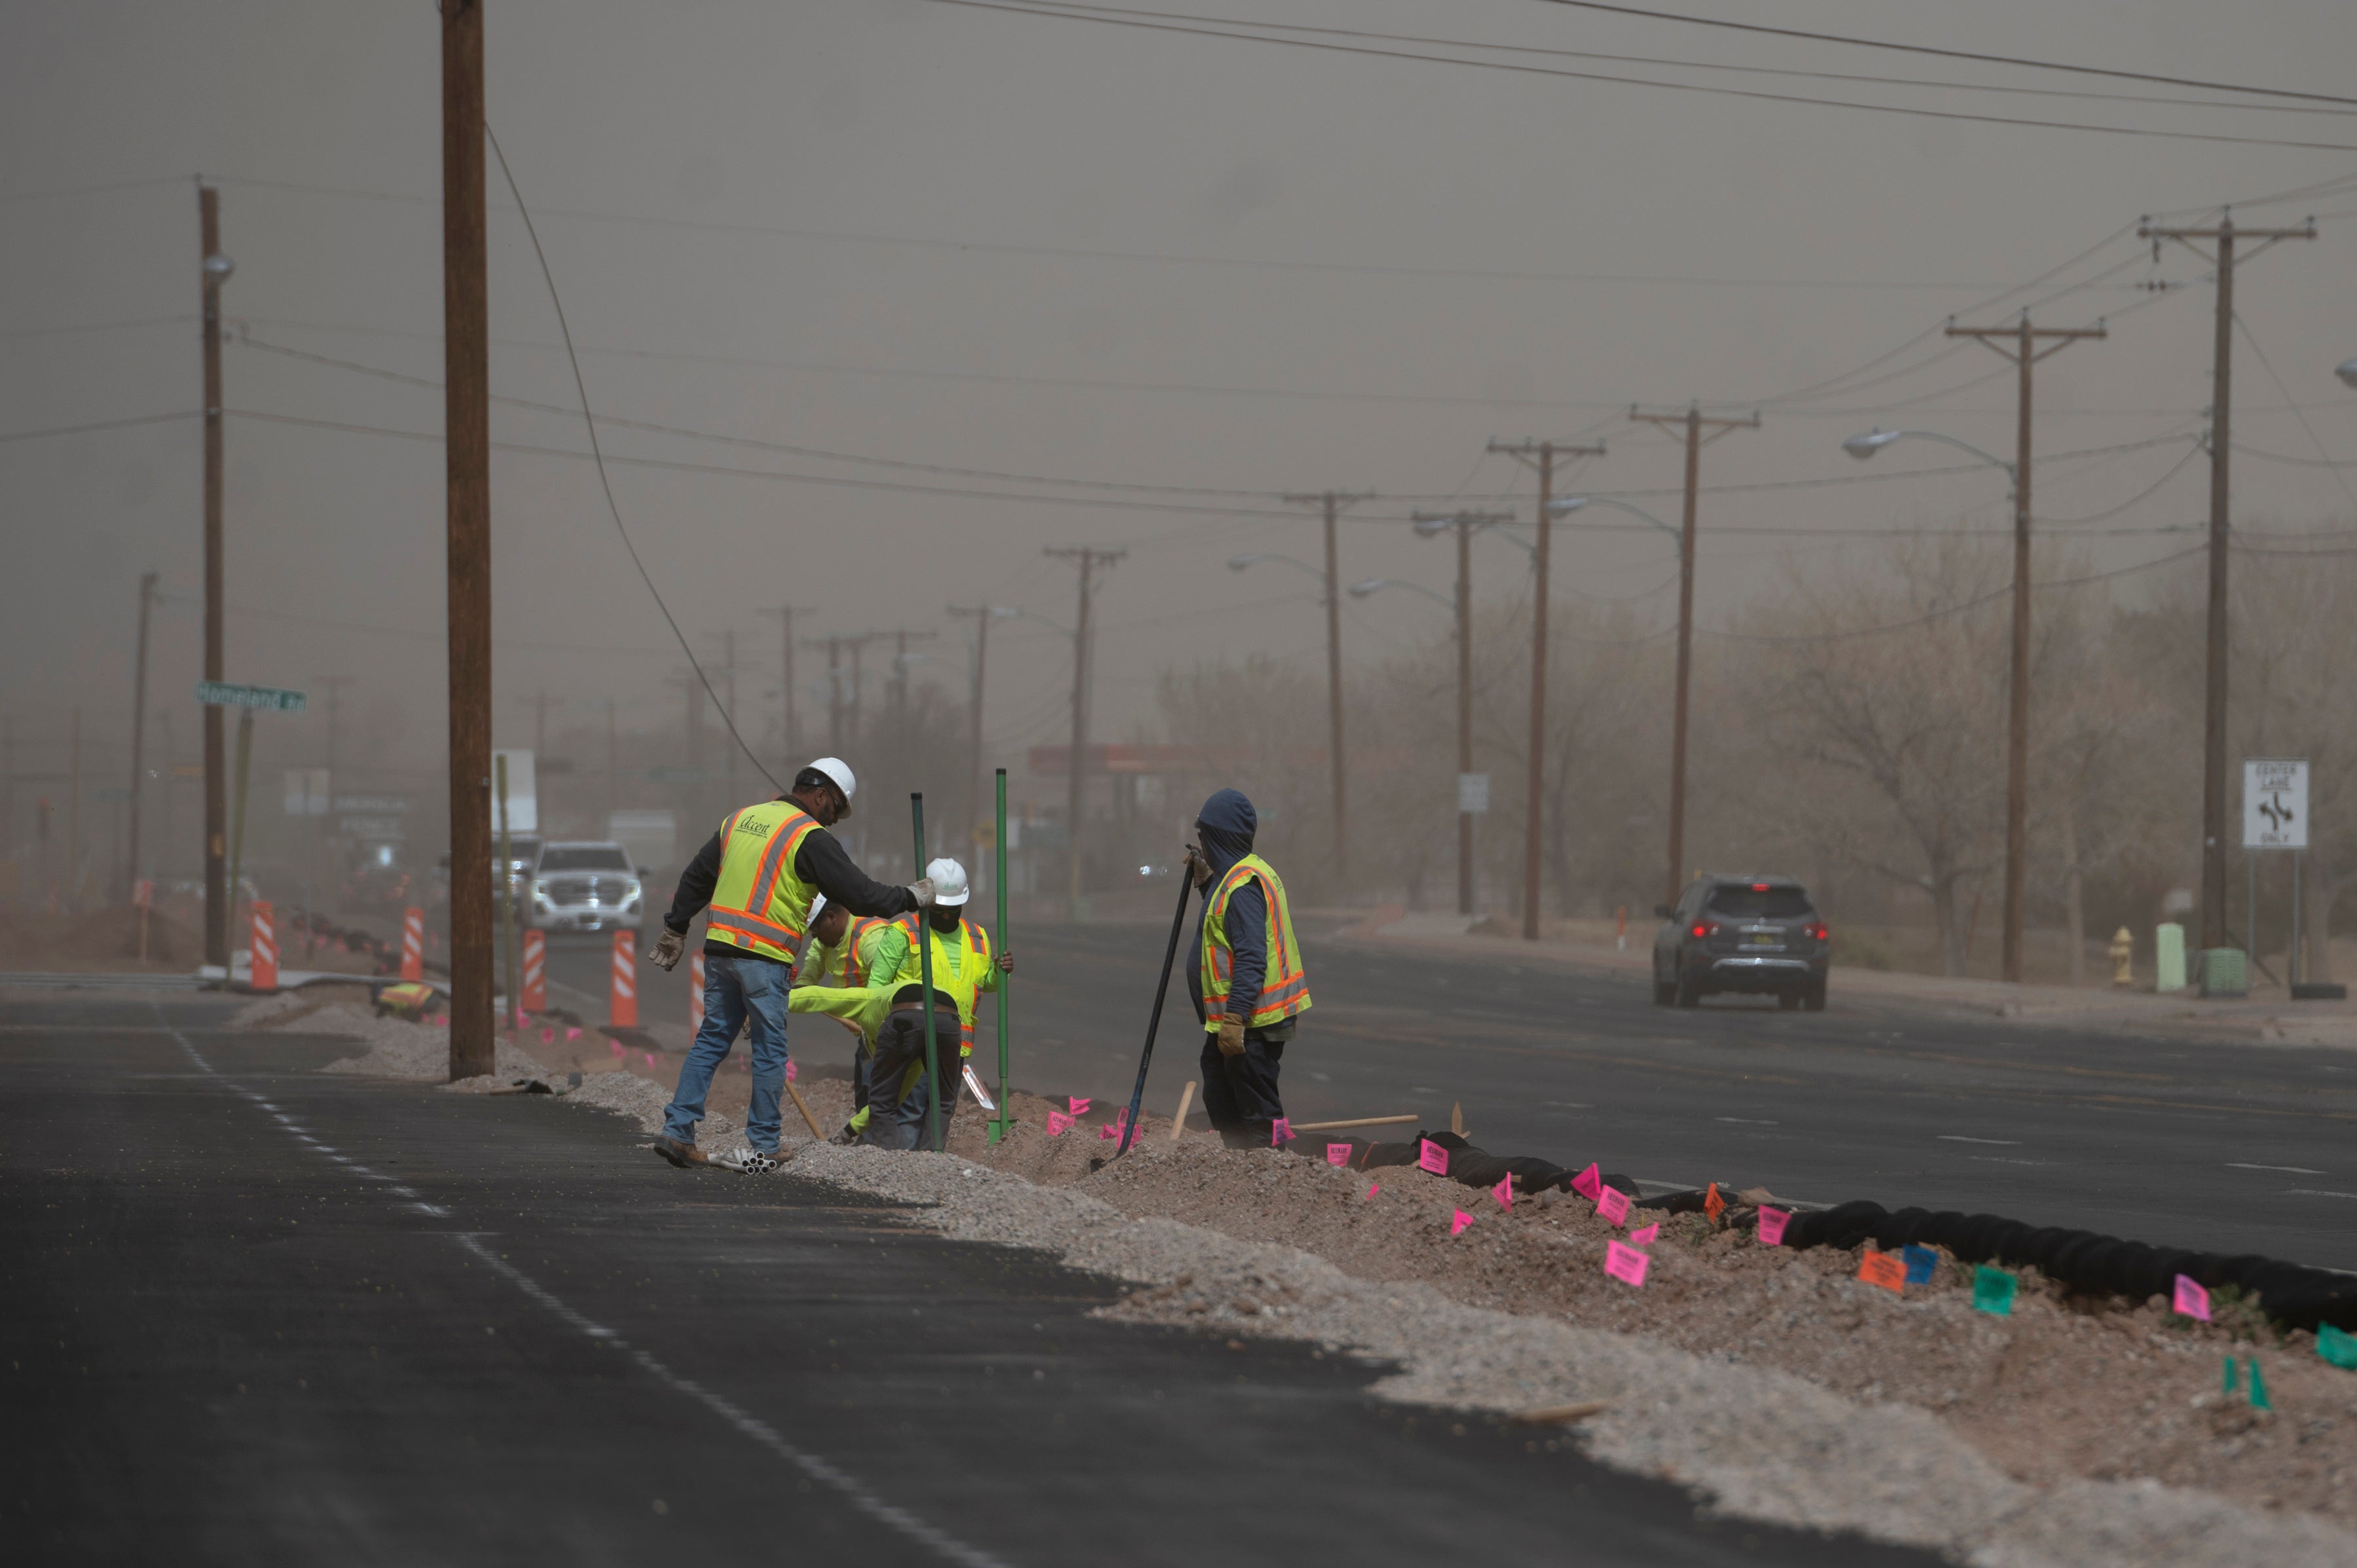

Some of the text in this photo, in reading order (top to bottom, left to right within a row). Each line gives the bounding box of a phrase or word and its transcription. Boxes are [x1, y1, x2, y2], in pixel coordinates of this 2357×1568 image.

[2256, 763, 2297, 775] CENTER
[2262, 776, 2290, 787] LANE
[2261, 833, 2289, 843] ONLY
